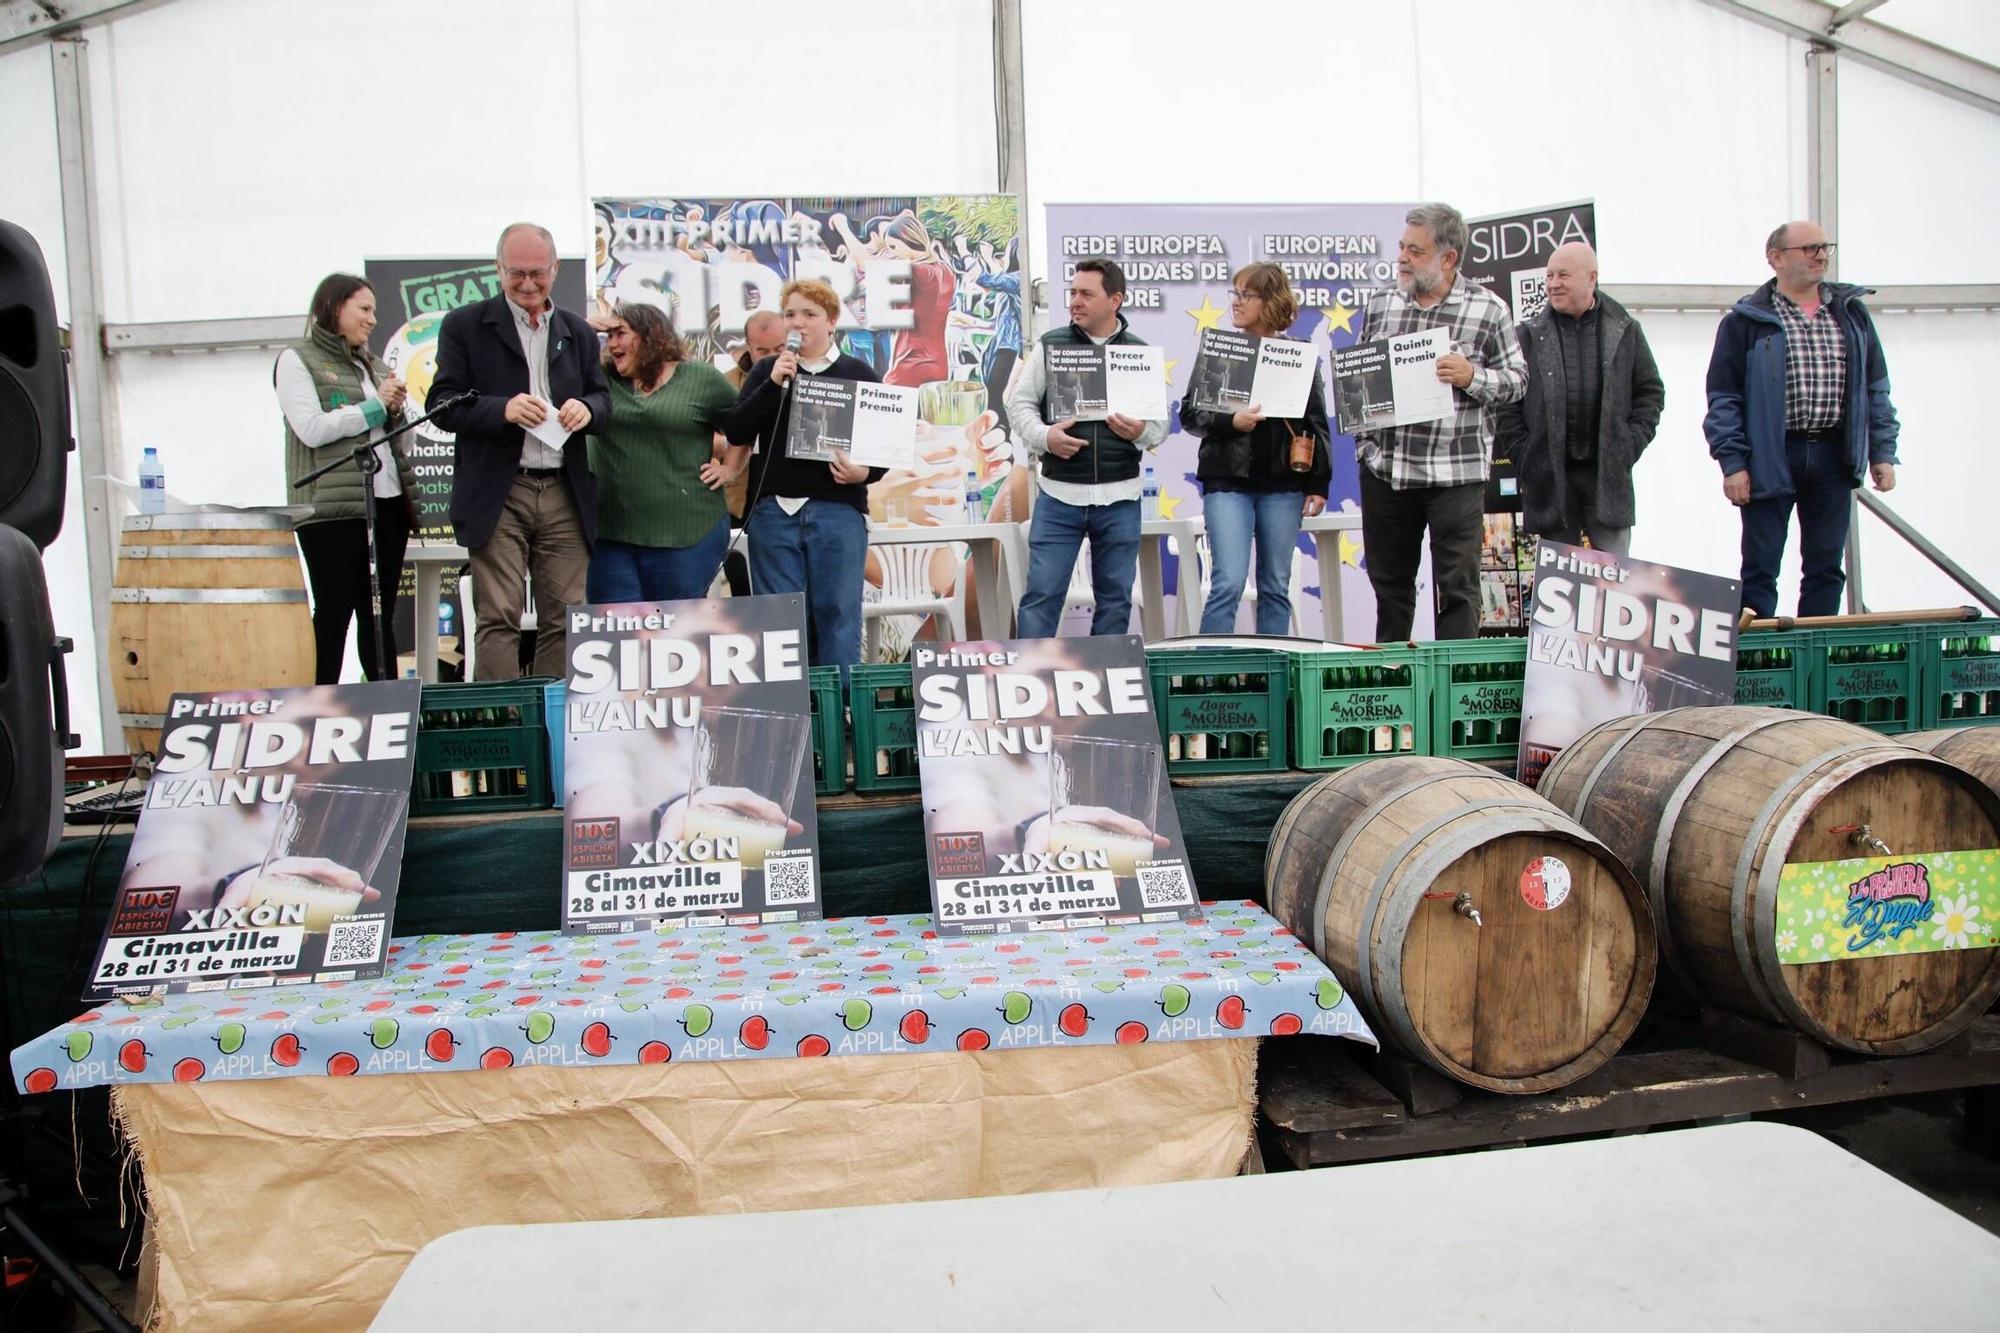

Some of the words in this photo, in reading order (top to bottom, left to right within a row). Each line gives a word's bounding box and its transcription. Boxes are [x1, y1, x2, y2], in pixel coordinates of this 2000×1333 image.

[611, 219, 672, 248] XIII
[688, 218, 823, 247] PRIMER
[1471, 212, 1590, 263] SIDRA
[1062, 235, 1117, 256] REDE
[1122, 235, 1224, 255] EUROPEA
[1263, 235, 1377, 255] EUROPEAN
[1122, 262, 1194, 281] UDAES
[1200, 261, 1228, 281] DE
[1282, 261, 1368, 281] ETWORK
[414, 275, 501, 312] GRAT
[615, 259, 916, 330] SIDRE
[1125, 288, 1161, 308] DRE
[1296, 287, 1330, 307] DER
[1109, 351, 1145, 360] Tercer
[1264, 343, 1302, 357] Cuartu
[1393, 338, 1433, 352] Quintu
[1110, 363, 1151, 372] Premiu
[1262, 355, 1302, 369] Premiu
[1394, 350, 1436, 366] Premiu
[860, 388, 903, 400] Primer
[859, 400, 903, 413] Premiu
[1539, 545, 1631, 584] Primer
[571, 610, 677, 634] Primer
[1533, 576, 1734, 663] SIDRE
[569, 629, 803, 694] SIDRE
[916, 648, 1019, 668] Primer
[918, 667, 1149, 723] SIDRE
[1475, 686, 1516, 699] Llagar
[1845, 678, 1899, 691] MORENA
[170, 697, 286, 720] Primer
[1198, 699, 1242, 713] Llagar
[1347, 693, 1389, 706] Llagar
[1469, 697, 1522, 711] MOREN
[1191, 712, 1258, 725] MORENA
[1340, 704, 1404, 718] MORENA
[155, 711, 412, 774] SIDRE
[630, 832, 740, 865] XIXÓN
[765, 847, 812, 857] Programa
[996, 845, 1110, 875] XIXÓN
[1135, 856, 1182, 867] Programa
[585, 868, 721, 894] Cimavilla
[954, 874, 1095, 899] Cimavilla
[571, 897, 594, 913] 28
[600, 894, 618, 912] al
[625, 893, 647, 911] 31
[654, 892, 677, 909] de
[683, 890, 741, 907] marzu
[942, 901, 967, 917] 28
[974, 899, 991, 915] al
[998, 899, 1023, 913] 31
[1029, 896, 1051, 912] de
[1058, 894, 1117, 910] marzu
[116, 921, 163, 931] ABIERTA
[119, 911, 167, 922] ESPICHA
[180, 899, 309, 932] XIXÓN
[333, 912, 386, 923] Programa
[123, 930, 280, 960] Cimavilla
[100, 962, 128, 978] 28
[135, 959, 157, 976] al
[163, 958, 190, 975] 31
[197, 955, 225, 972] de
[230, 952, 296, 970] marzu
[998, 1023, 1067, 1048] APPLE
[1156, 1015, 1225, 1039] APPLE
[520, 1041, 588, 1066] APPLE
[678, 1035, 747, 1060] APPLE
[838, 1030, 906, 1055] APPLE
[212, 1054, 278, 1076] APPLE
[366, 1043, 432, 1072] APPLE
[63, 1061, 130, 1084] APPLE
